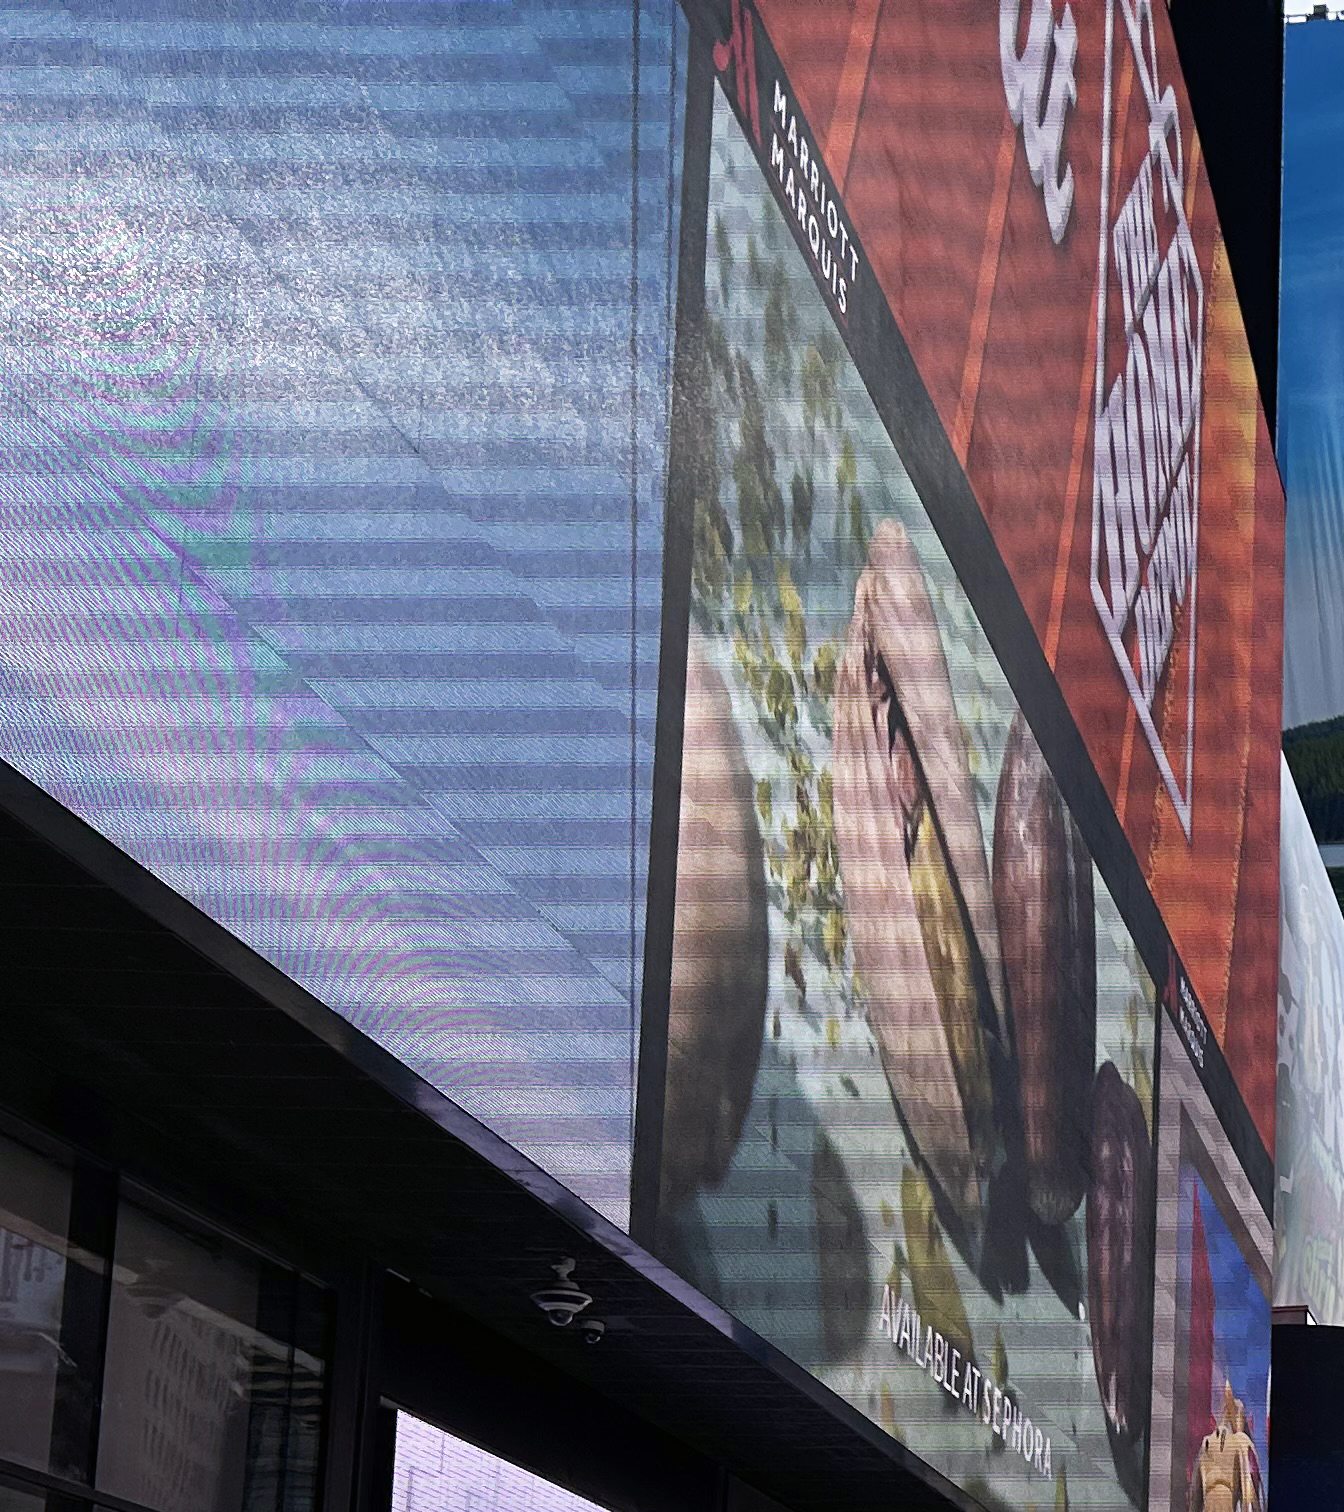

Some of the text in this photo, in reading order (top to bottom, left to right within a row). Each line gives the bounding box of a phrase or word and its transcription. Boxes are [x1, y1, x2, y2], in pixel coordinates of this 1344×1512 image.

[770, 135, 850, 316] MARQUIS
[773, 80, 859, 283] MARRIOTT
[880, 1284, 1053, 1479] AVAILABLE AT SEPHORA
